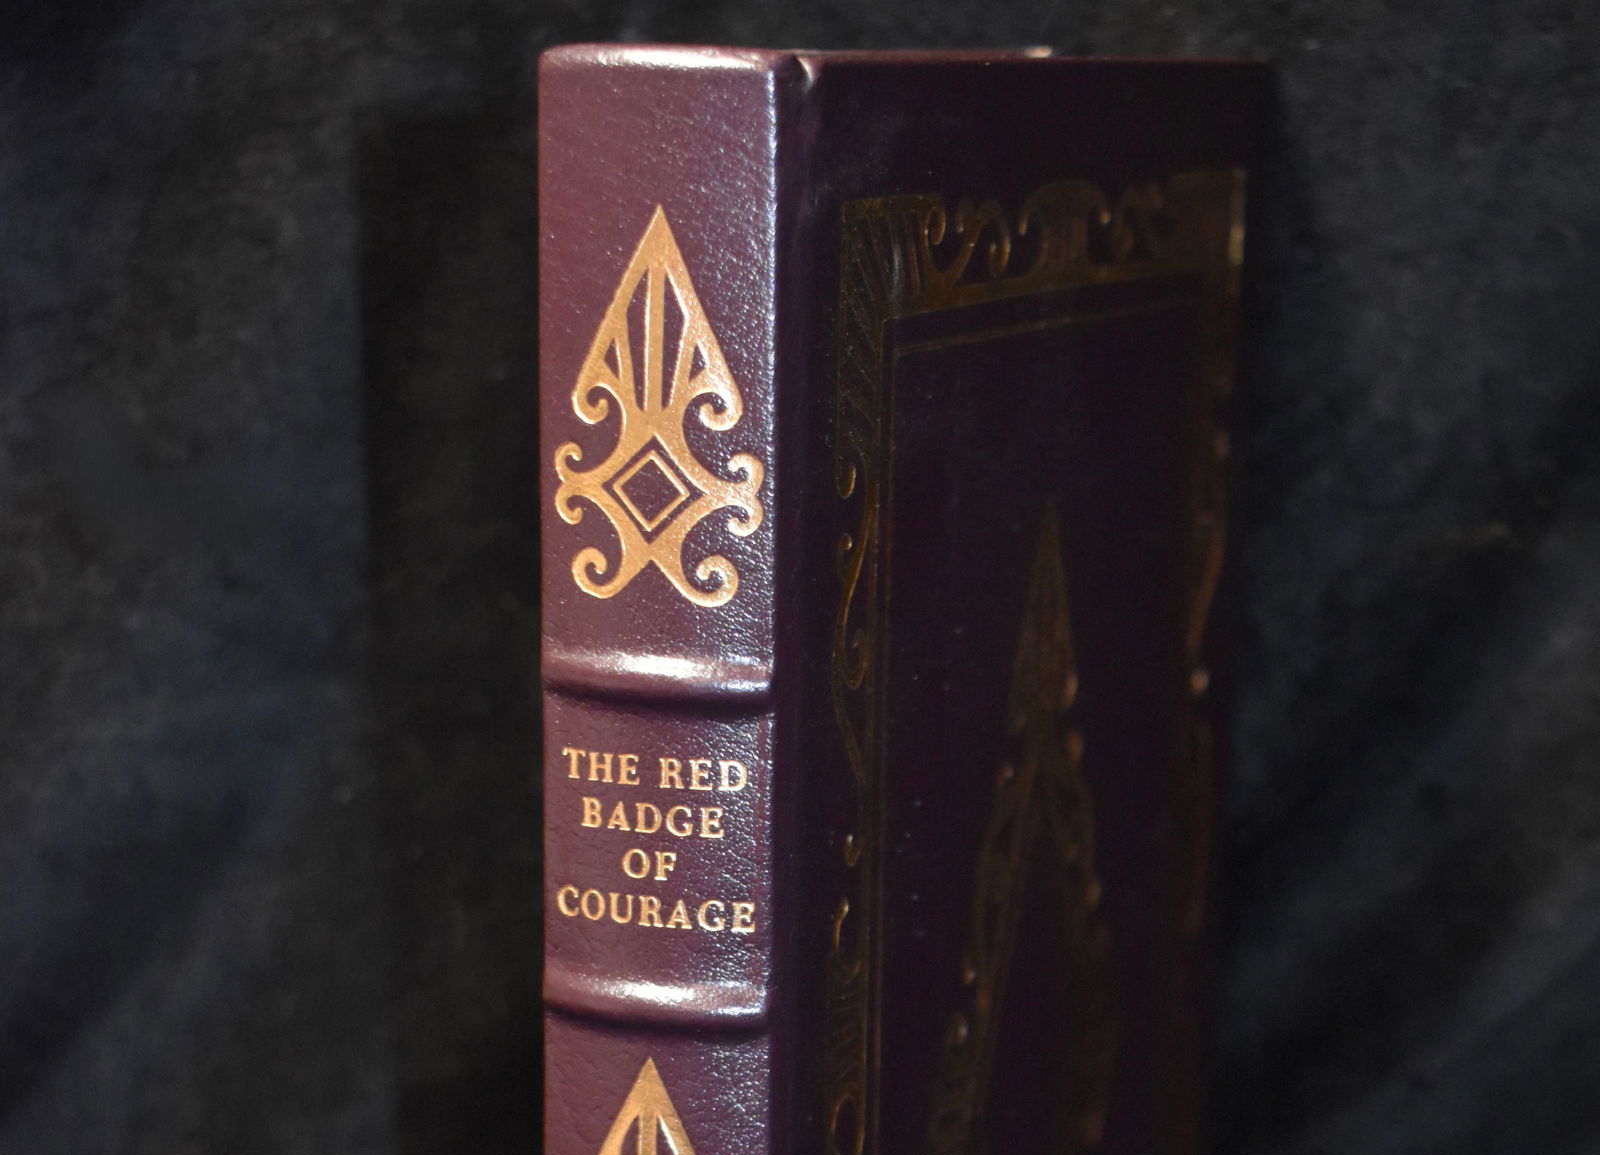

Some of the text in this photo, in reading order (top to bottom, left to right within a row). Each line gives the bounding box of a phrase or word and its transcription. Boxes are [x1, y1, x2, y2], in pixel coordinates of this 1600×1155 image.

[562, 747, 748, 791] THE RED
[581, 797, 725, 839] BADGE
[622, 848, 677, 881] OF
[557, 885, 756, 933] COURAGE
